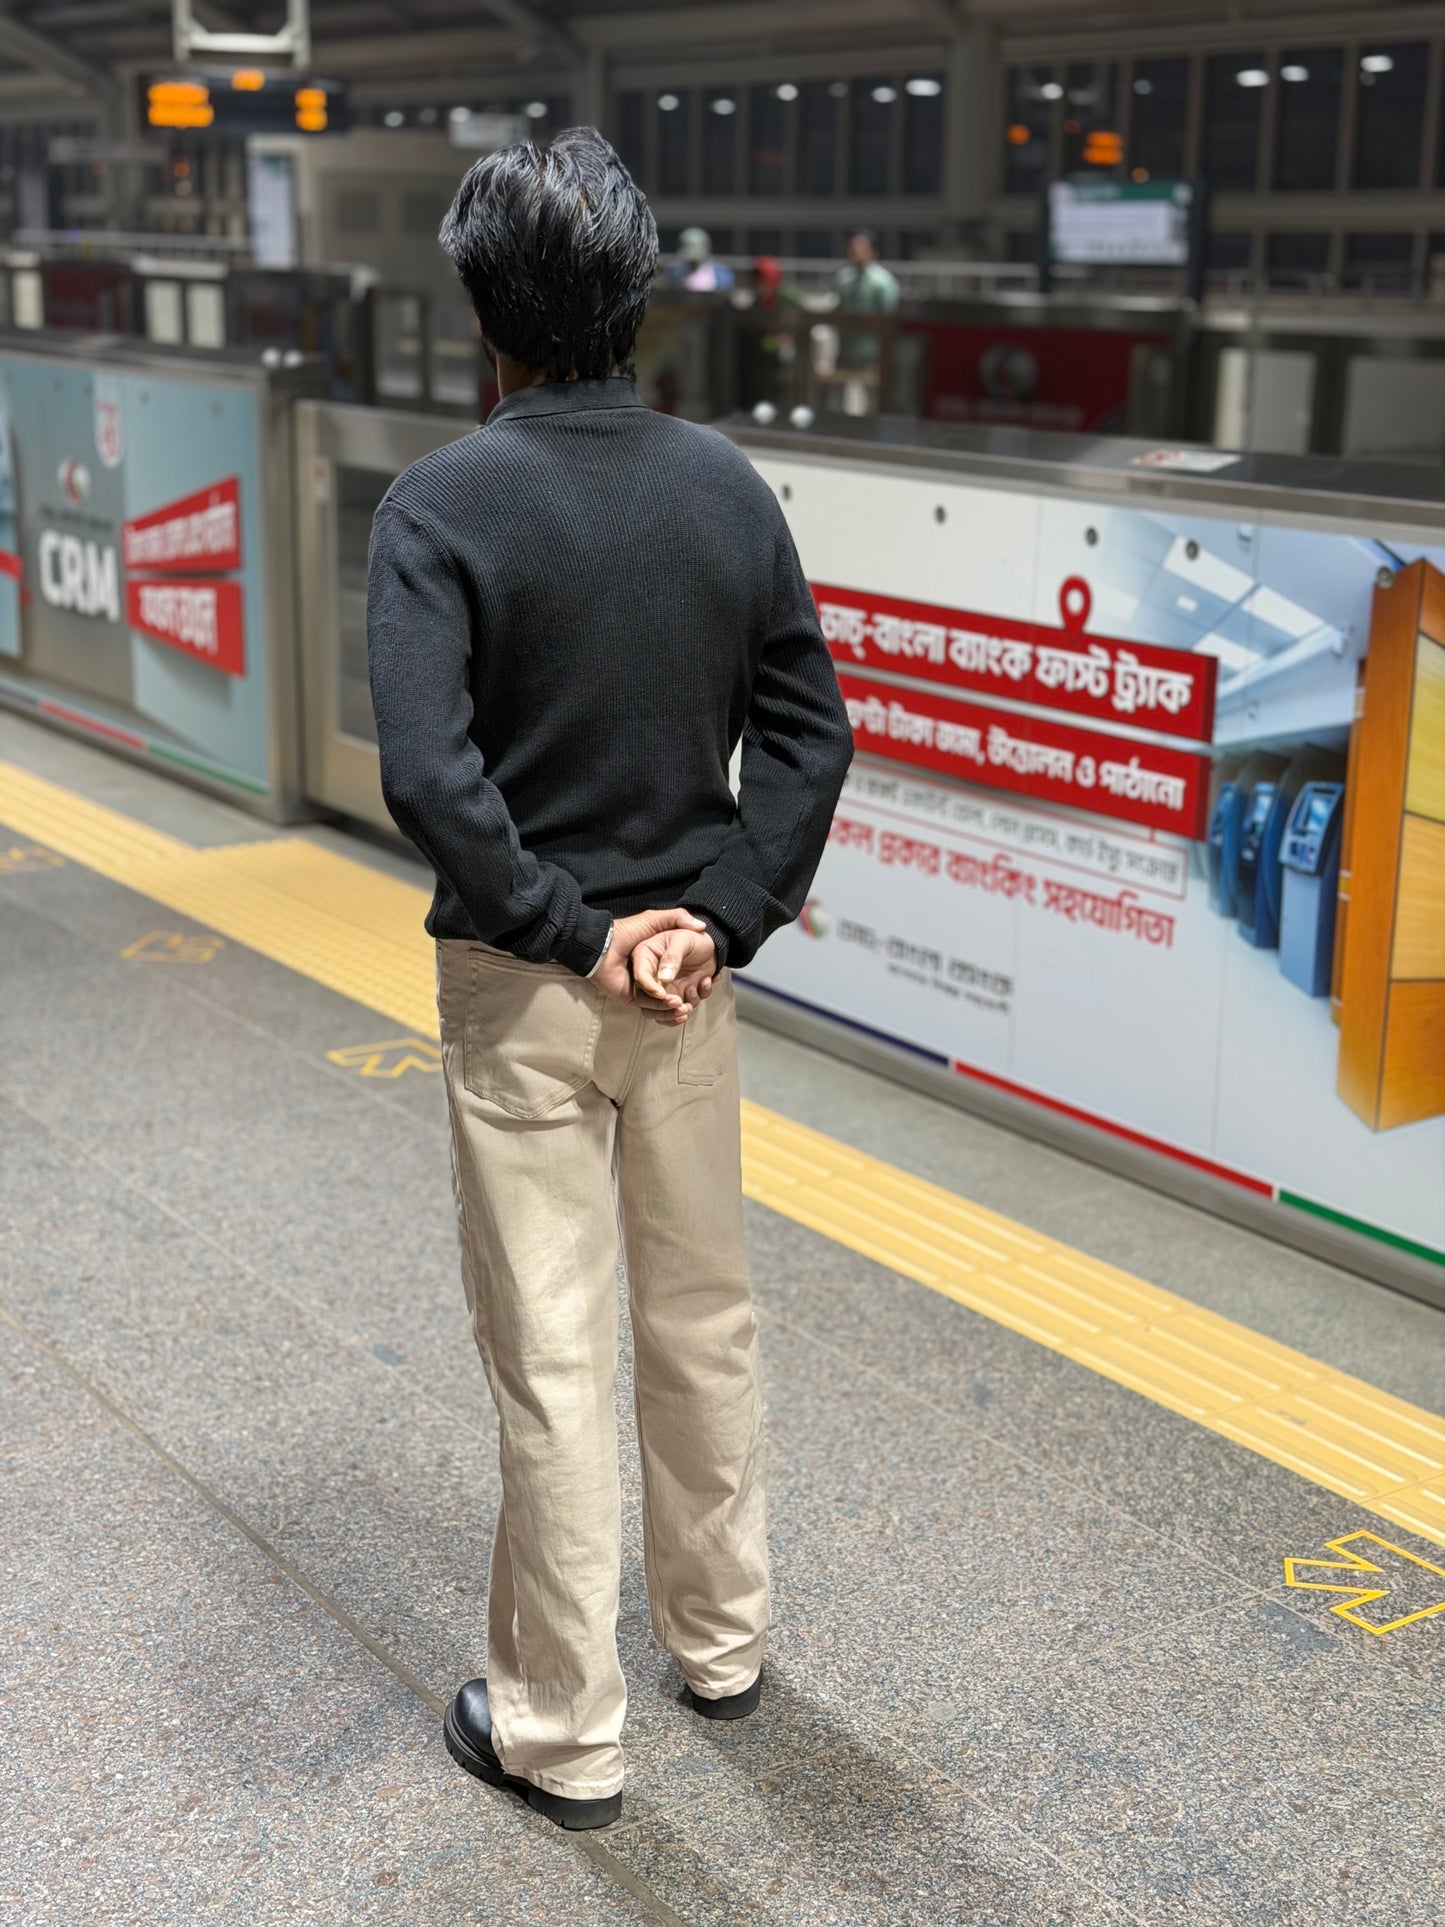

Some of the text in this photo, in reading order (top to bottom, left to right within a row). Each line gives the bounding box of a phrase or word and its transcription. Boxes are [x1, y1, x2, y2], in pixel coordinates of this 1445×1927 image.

[39, 529, 120, 623] CRM
[818, 602, 1194, 714] ডাচ্-বাংলা ব্যাংক ফাস্ট ট্র্যাক
[1075, 755, 1097, 788] ও
[1098, 755, 1187, 812] পাঠানো
[878, 829, 941, 876] প্রকার
[946, 848, 1036, 906] ব্যাংকিং
[1042, 878, 1176, 950] সহযোগিতা
